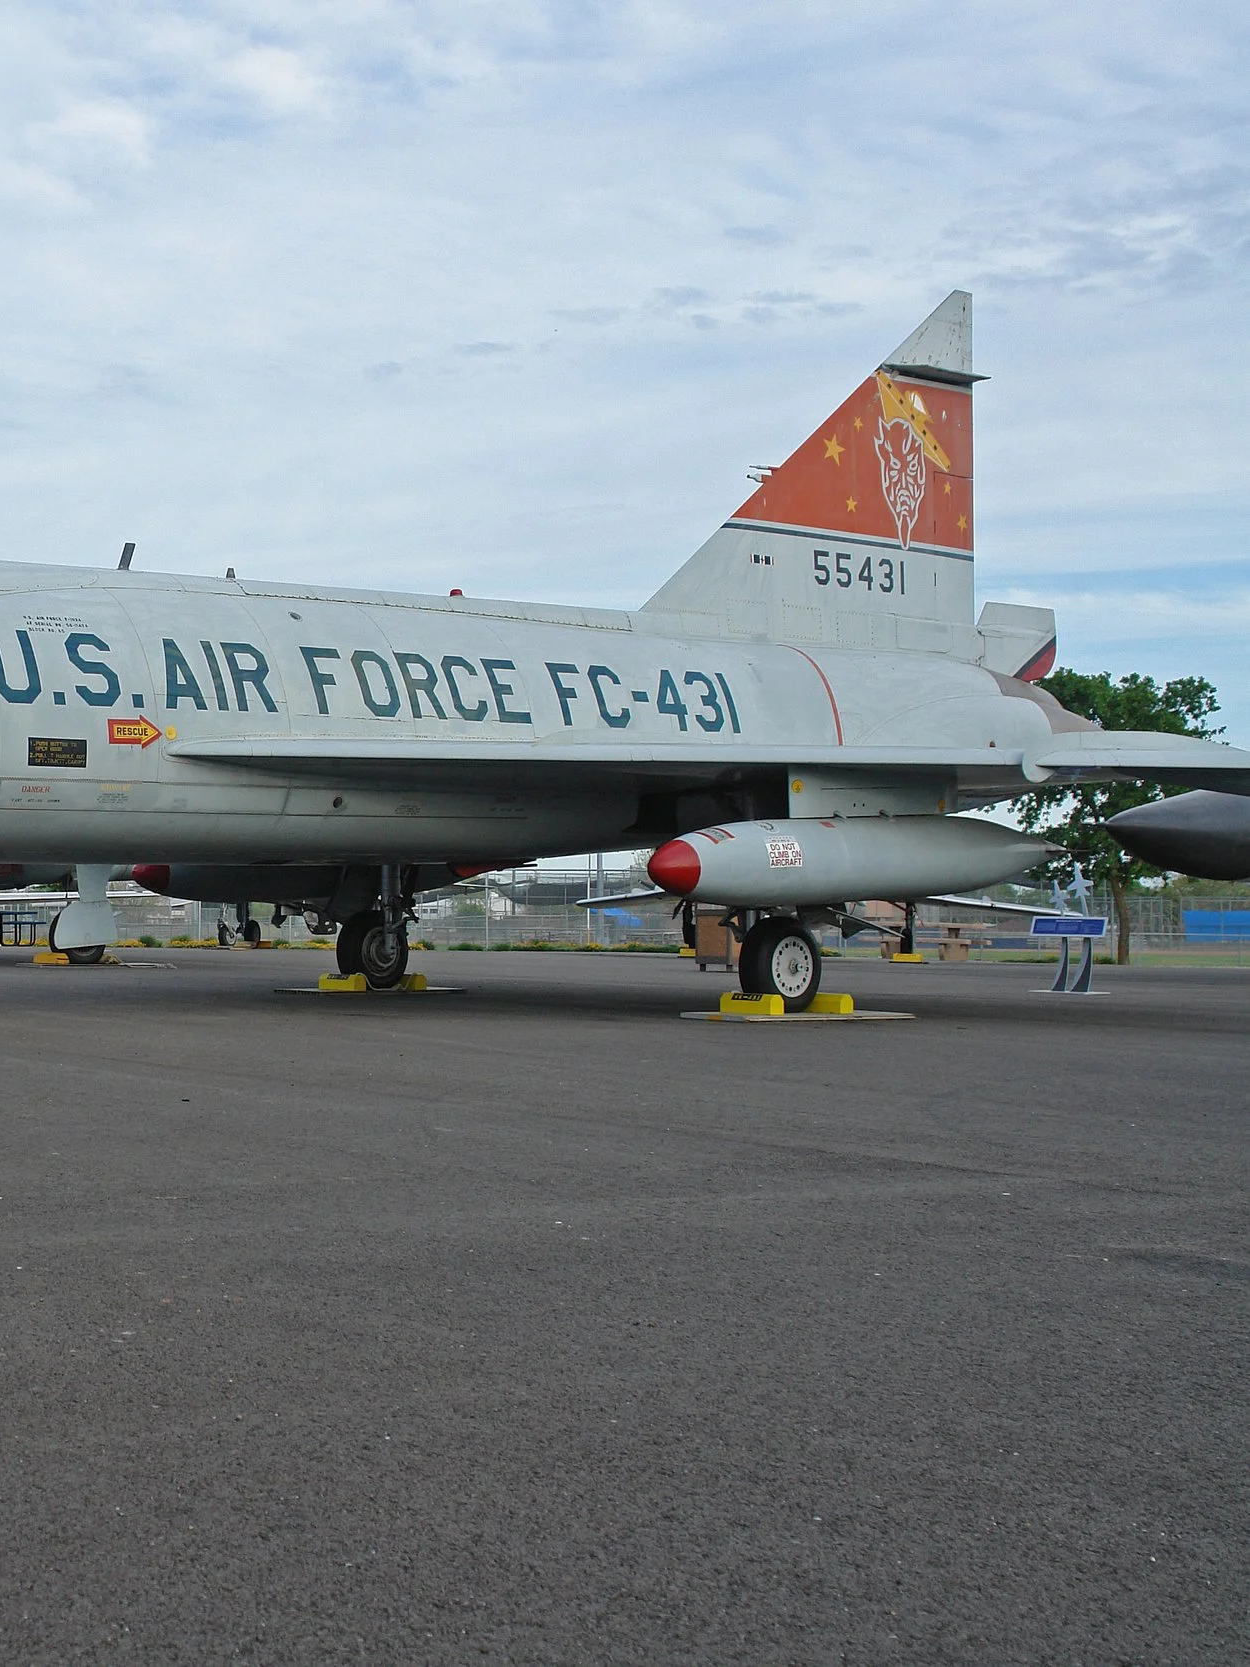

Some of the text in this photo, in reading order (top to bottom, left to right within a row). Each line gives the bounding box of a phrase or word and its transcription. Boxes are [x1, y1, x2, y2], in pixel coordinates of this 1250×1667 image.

[813, 549, 906, 596] 55431
[163, 639, 279, 713] AIR
[299, 646, 533, 724] FORCE
[545, 662, 741, 734] FC-431
[116, 726, 149, 736] RESCUE
[21, 785, 51, 793] DANGER
[770, 843, 796, 851] DO NOT
[770, 858, 802, 866] AIRCRAFT
